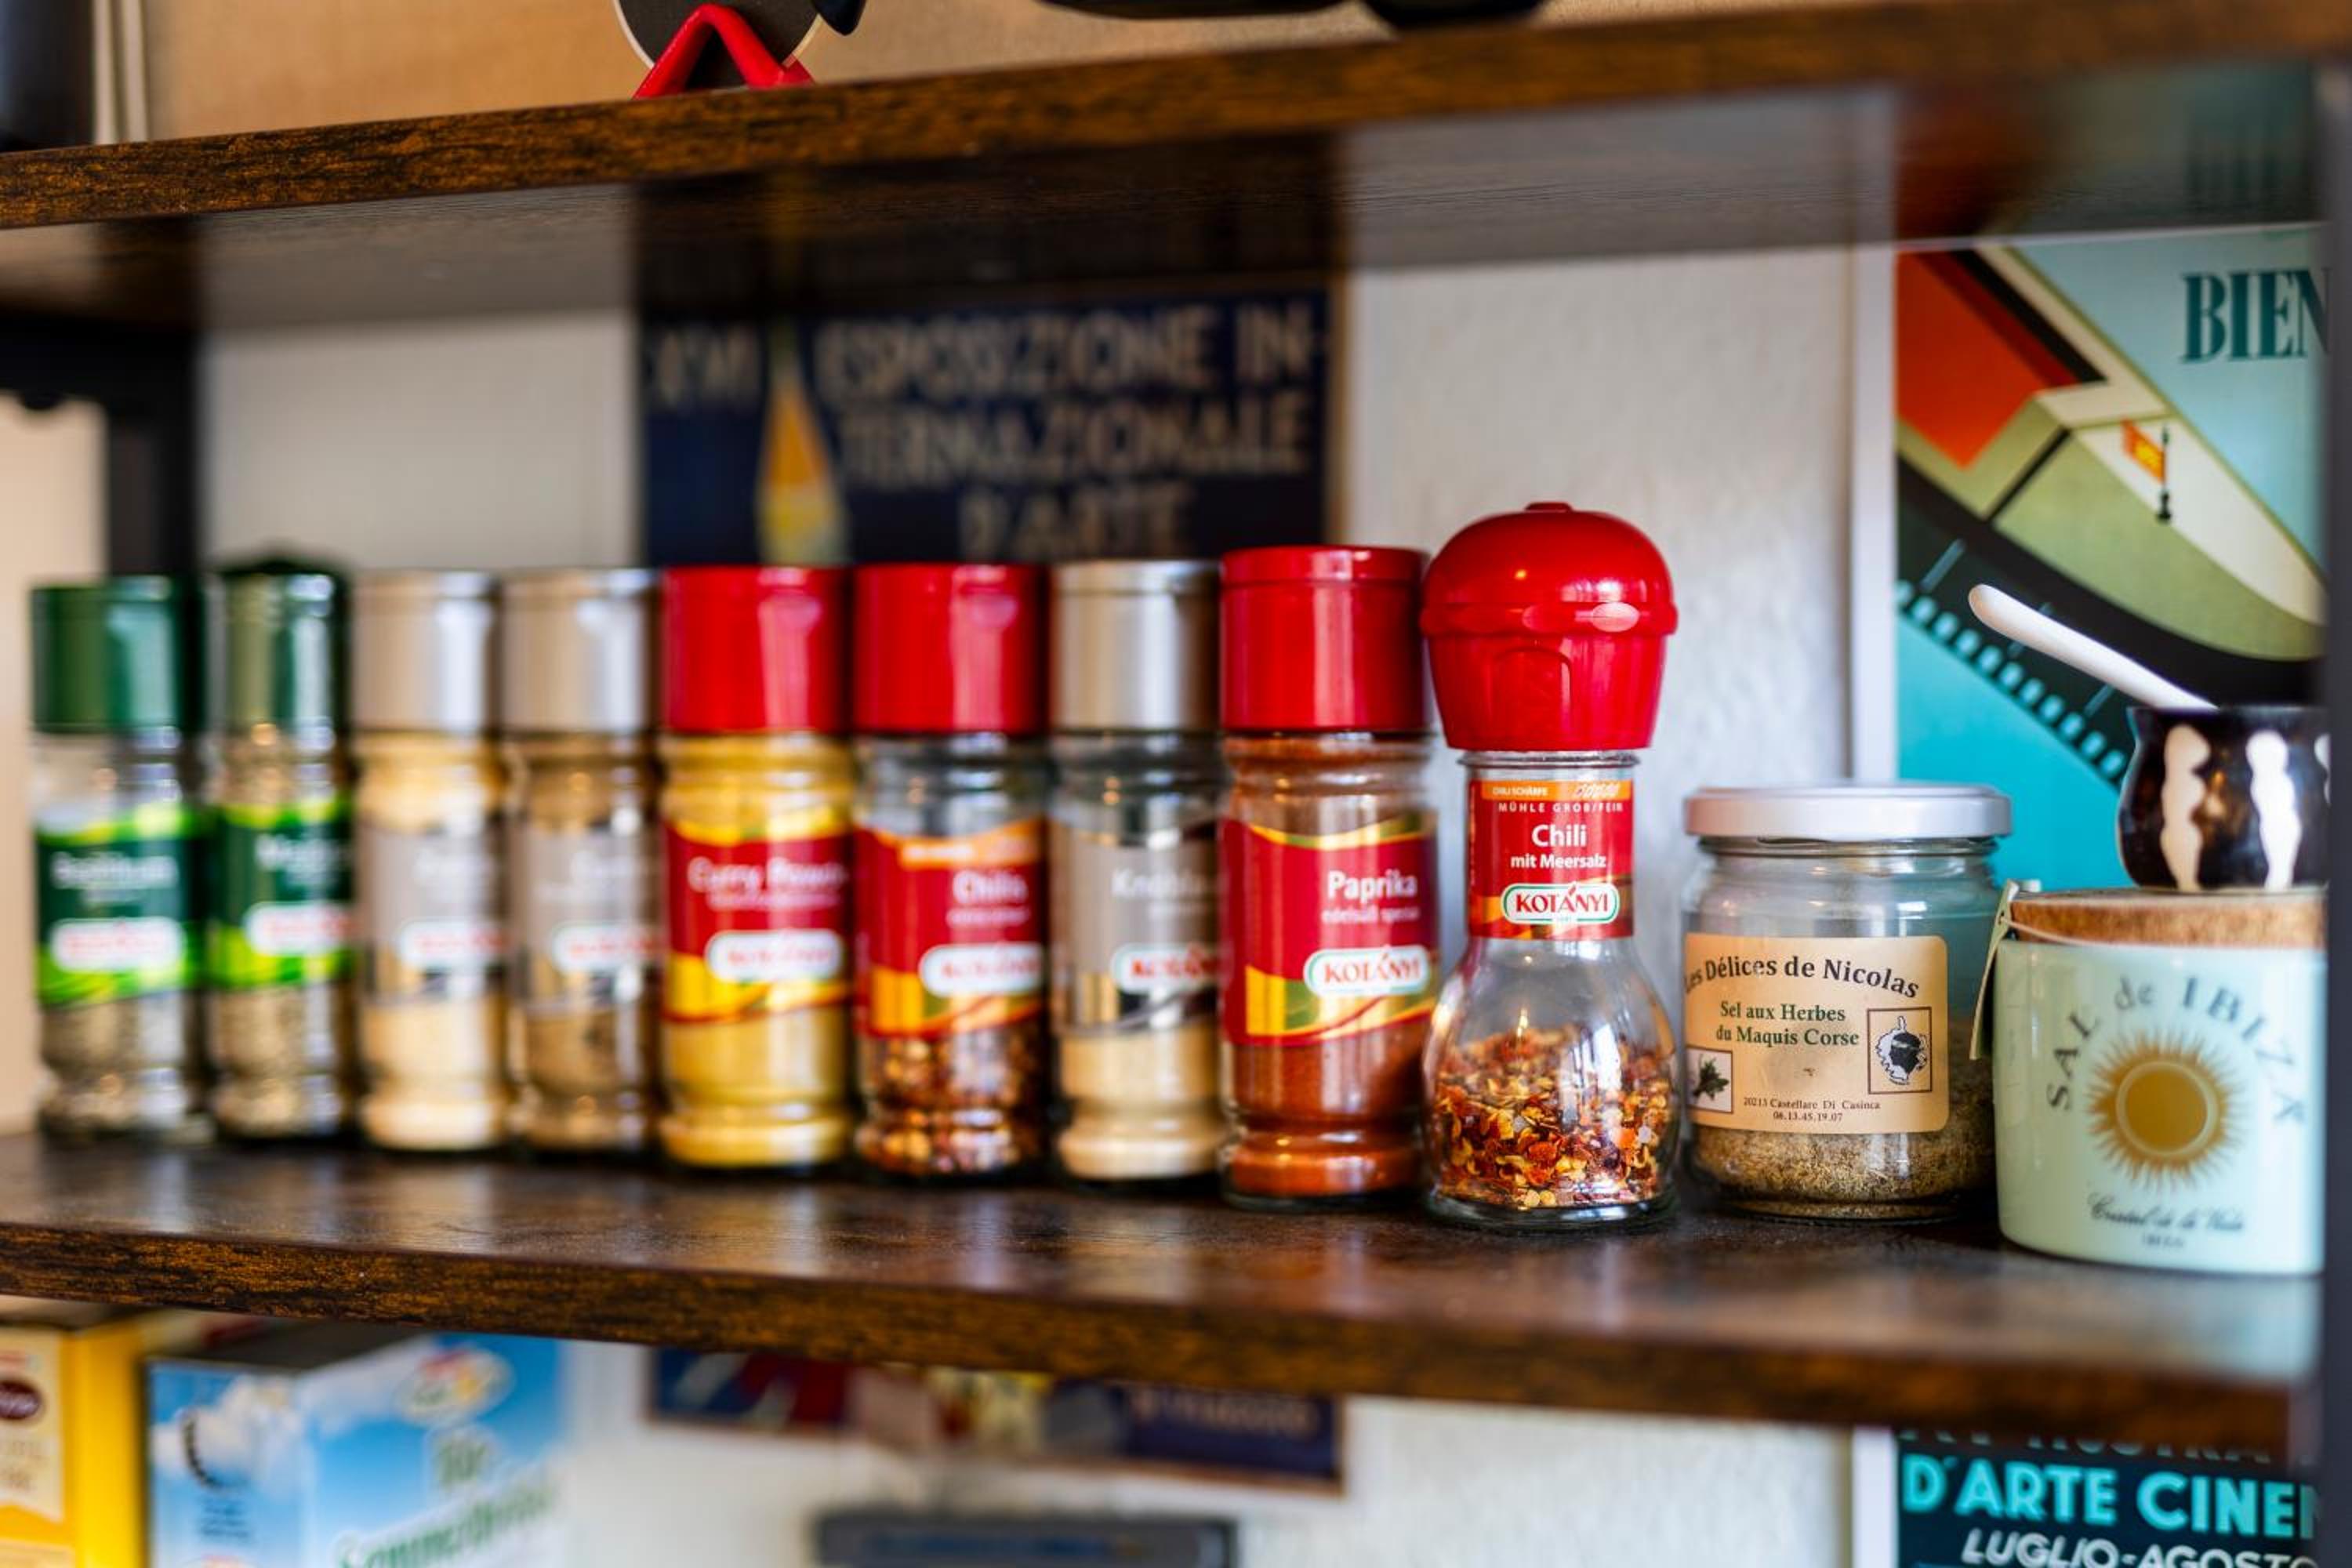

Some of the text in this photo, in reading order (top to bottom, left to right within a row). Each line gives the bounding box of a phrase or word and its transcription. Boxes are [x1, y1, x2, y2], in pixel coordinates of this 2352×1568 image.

[2180, 267, 2332, 363] BIEN
[1498, 801, 1545, 812] MÜHLE
[1531, 824, 1588, 848] Chili
[1511, 852, 1606, 868] mit Meersalz
[1327, 869, 1418, 904] Paprika
[1515, 884, 1609, 913] KOTÁNYI
[1705, 956, 1777, 981] Délices
[1784, 956, 1815, 978] de
[1823, 958, 1919, 999] Nicolas
[1720, 1000, 1846, 1022] Sel aux Herbes
[1715, 1025, 1859, 1047] du Maquis Corse
[2046, 1011, 2101, 1112] SAL
[2114, 976, 2154, 1011] de
[1769, 1098, 1818, 1109] Castellare
[1823, 1100, 1836, 1109] Di
[1842, 1101, 1881, 1109] Casinca
[1902, 1454, 2117, 1526] D'ARTE
